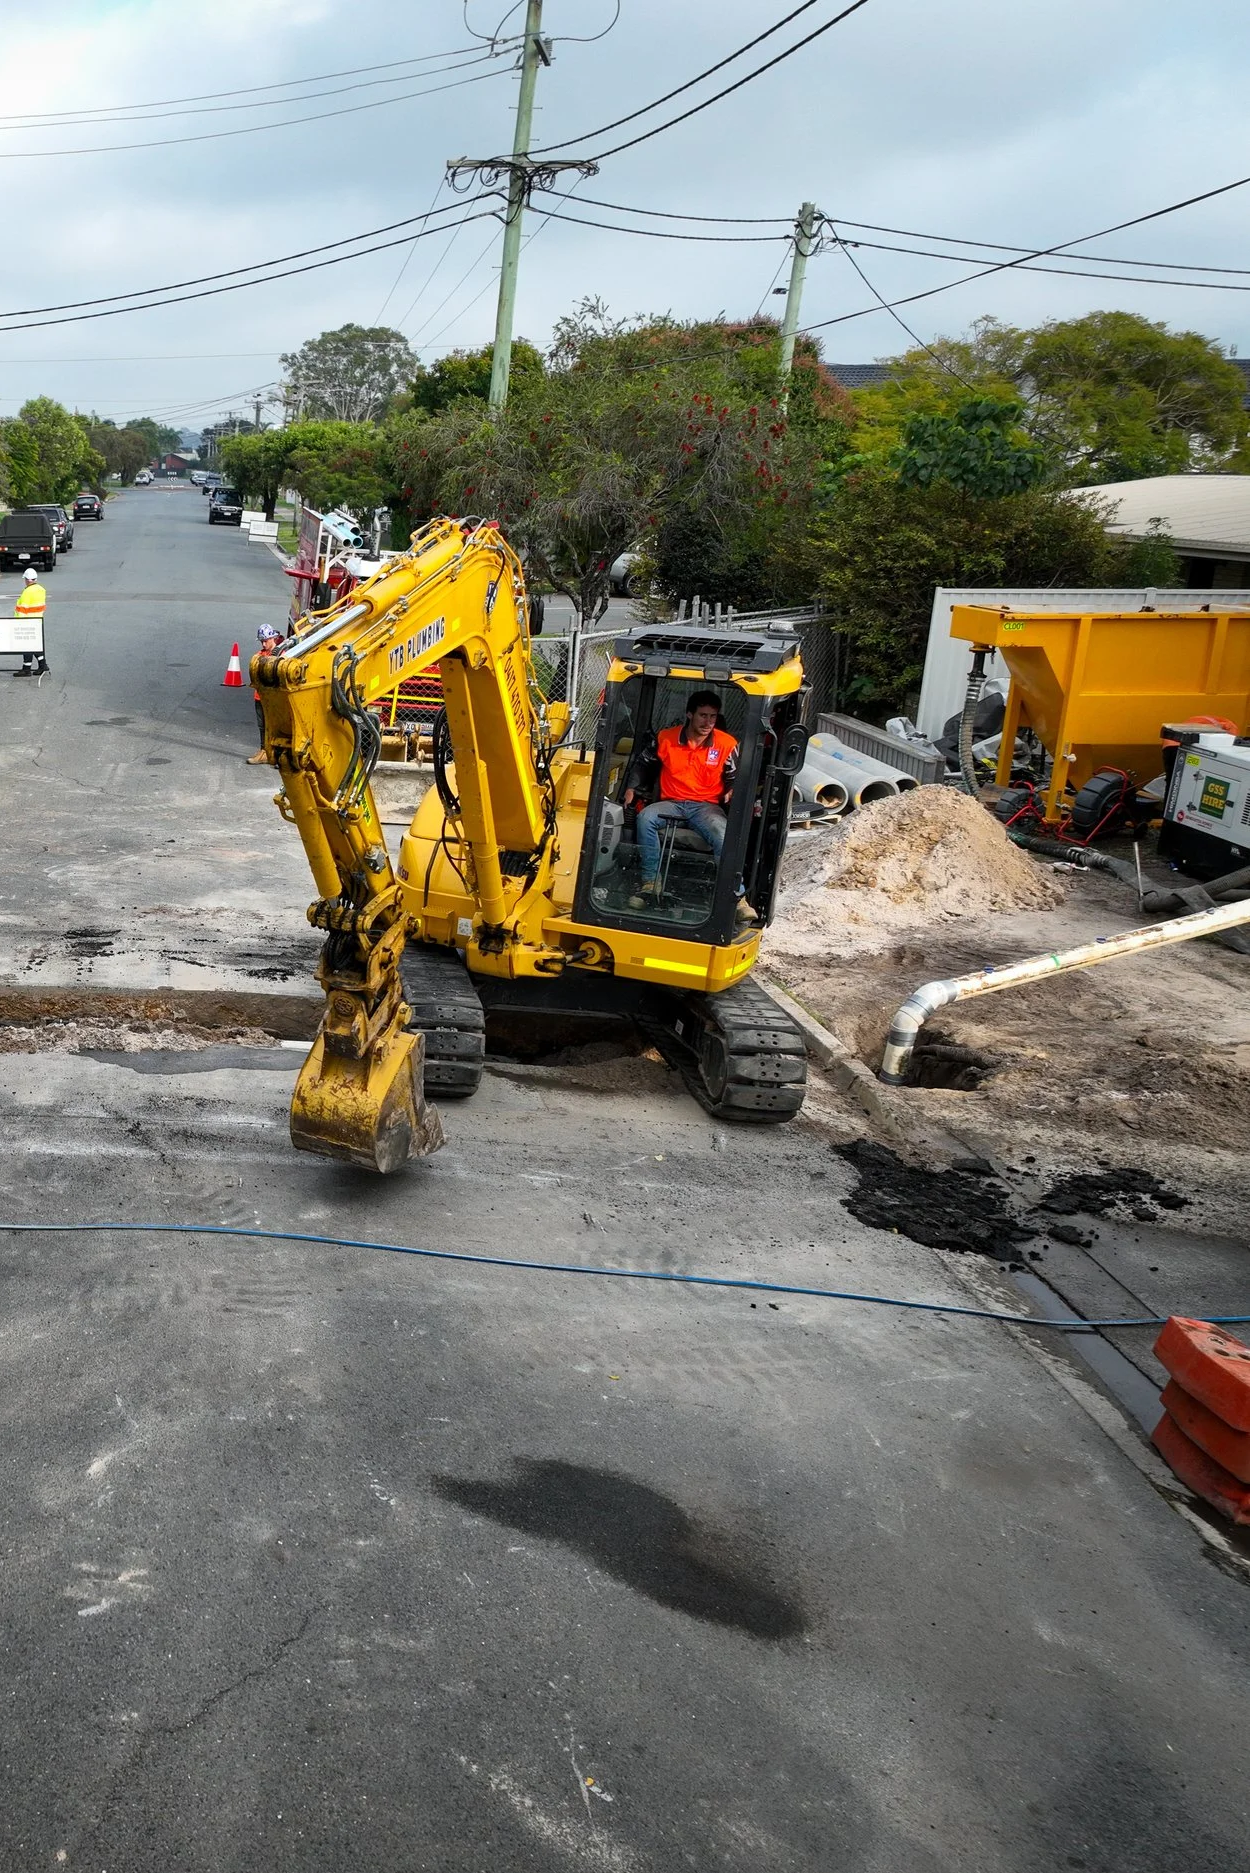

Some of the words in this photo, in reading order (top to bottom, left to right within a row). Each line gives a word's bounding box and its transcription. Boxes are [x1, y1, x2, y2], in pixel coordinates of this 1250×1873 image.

[1004, 622, 1024, 630] CL001
[388, 645, 404, 677] YTB
[407, 616, 445, 663] PLUMBING
[1208, 782, 1225, 796] GSS
[1201, 794, 1225, 809] HIRE
